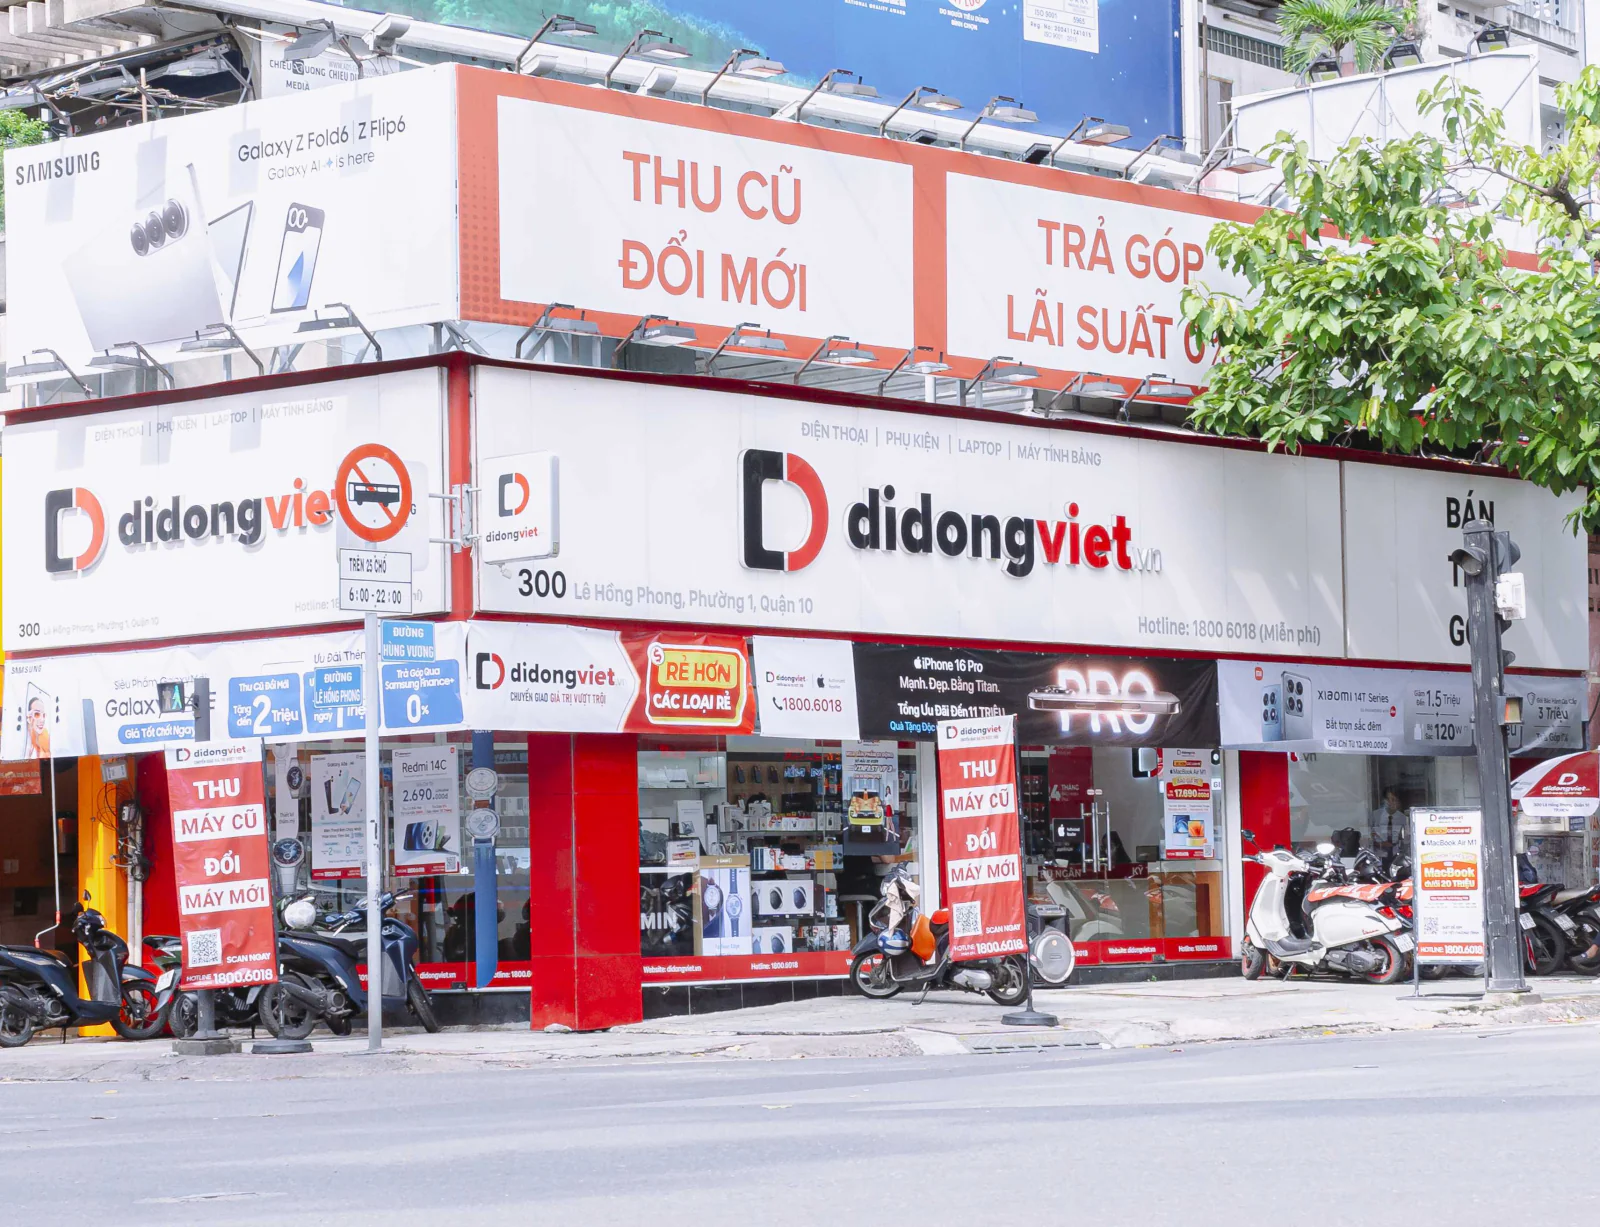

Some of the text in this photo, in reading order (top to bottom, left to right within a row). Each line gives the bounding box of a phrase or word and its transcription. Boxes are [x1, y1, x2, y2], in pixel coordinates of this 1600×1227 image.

[238, 115, 406, 163] Galaxy Z Fold6 Z Flip6
[15, 151, 101, 186] SAMSUNG
[267, 160, 308, 181] Galaxy
[335, 154, 345, 169] is
[347, 151, 376, 167] here
[622, 150, 802, 226] THU CŨ
[1037, 215, 1205, 286] TRẢ GÓP
[618, 229, 807, 312] ĐỔI MỚI
[1006, 287, 1065, 348] LÃI
[1076, 302, 1174, 361] SUẤT
[801, 421, 831, 442] ĐIỆN
[832, 425, 869, 444] THOẠI
[885, 430, 911, 450] PHỤ
[913, 431, 940, 450] KIỆN
[958, 437, 1002, 457] LAPTOP
[1017, 441, 1041, 461] MÁY
[1041, 443, 1069, 464] TÍNH
[1446, 490, 1495, 530] BÁN
[485, 526, 539, 543] didongviet
[366, 558, 374, 574] 25
[518, 568, 567, 599] 300
[574, 582, 592, 601] Lê
[594, 582, 634, 606] Hồng
[637, 586, 686, 608] Phong,
[689, 589, 745, 613] Phường
[760, 595, 796, 617] Quận
[798, 598, 814, 614] 10
[19, 622, 41, 638] 300
[1138, 615, 1321, 646] Hotline: 1800 6018 (Miễn phí)
[396, 666, 440, 679] Trả Góp Qua
[666, 654, 732, 683] RẺ HƠN
[921, 657, 983, 674] iPhone 16 Pro
[239, 682, 252, 692] Thu
[252, 680, 264, 692] Cũ
[264, 679, 276, 691] Đổi
[385, 679, 419, 692] Samsung
[899, 675, 1001, 695] Mạnh. Đẹp. Bằng Titan.
[652, 689, 732, 714] CÁC LOẠI RẺ
[783, 697, 843, 713] 1800.6018
[1057, 668, 1156, 734] PRO
[1354, 692, 1366, 703] 14T
[1368, 692, 1389, 704] Series
[1426, 690, 1442, 707] 1.5
[1443, 692, 1461, 706] Triệu
[233, 704, 252, 717] Tặng
[252, 693, 272, 735] 2
[271, 707, 299, 726] Triệu
[313, 711, 334, 724] ngay
[898, 701, 920, 719] Tổng
[921, 703, 934, 717] Ưu
[934, 702, 949, 717] Đãi
[949, 702, 968, 718] Đến
[968, 705, 978, 718] 11
[236, 713, 252, 727] đến
[889, 720, 936, 733] Quà Tặng Độc
[1325, 716, 1382, 733] Bắt trọn sắc đêm
[124, 724, 195, 740] Giá Tốt Chốt Ngay
[960, 724, 1002, 737] didongviet
[193, 745, 247, 758] didongviet
[402, 759, 448, 773] Redmi 14C
[959, 759, 997, 779] THU
[192, 777, 241, 800] THU
[950, 787, 1010, 813] MÁY CŨ
[181, 808, 257, 836] MÁY CŨ
[966, 826, 997, 852] ĐỔI
[204, 849, 241, 877] ĐỔI
[951, 857, 1016, 883] MÁY MỚI
[1423, 866, 1476, 878] MacBook
[1440, 879, 1452, 888] 20
[1452, 878, 1476, 889] TRIỆU
[185, 883, 265, 910] MÁY MỚI
[985, 922, 1021, 934] SCAN NGAY
[975, 938, 1025, 955] 1800.6018
[1444, 944, 1483, 955] 1800.6018
[226, 952, 271, 964] SCAN NGAY
[751, 962, 771, 971] Hotline:
[186, 968, 273, 985] HOTLINE 1800.6018
[419, 971, 457, 981] didongviet.vn
[643, 965, 667, 974] Website:
